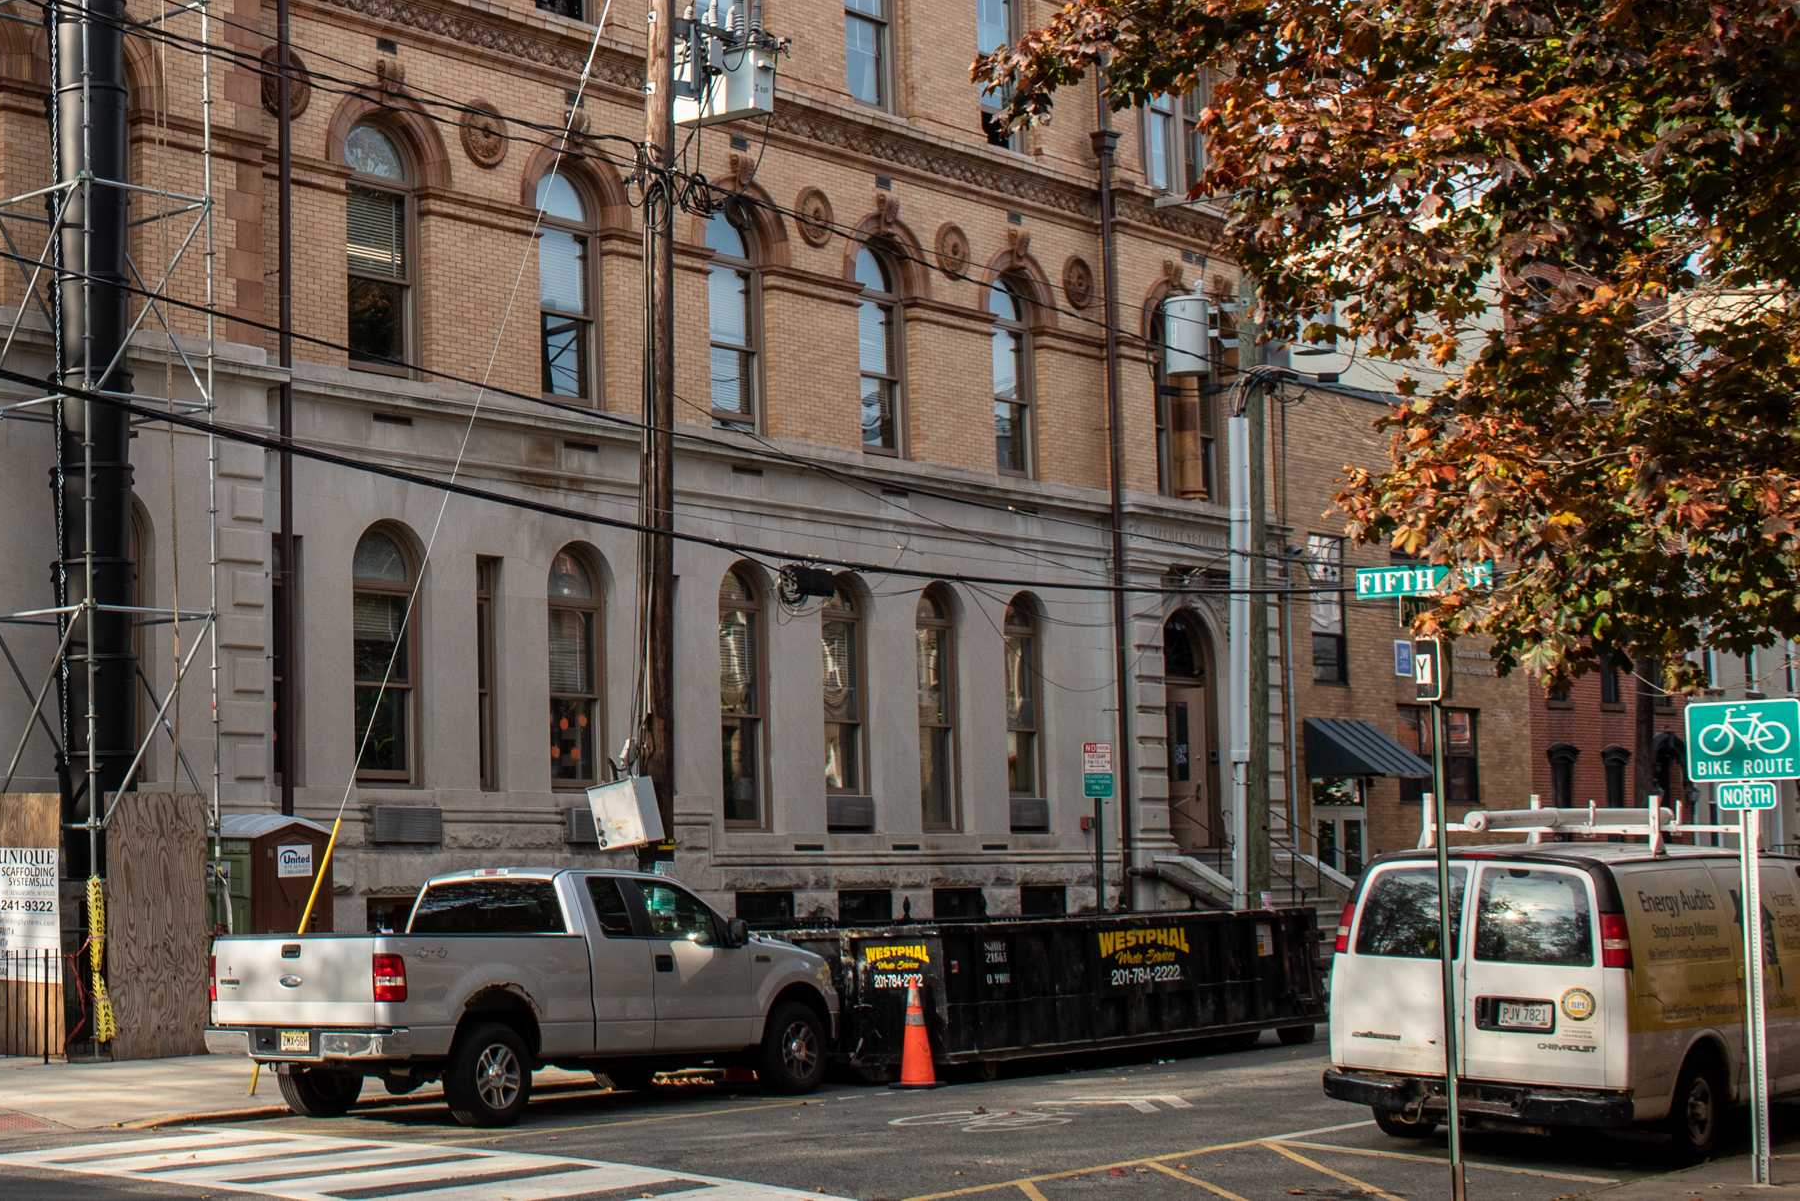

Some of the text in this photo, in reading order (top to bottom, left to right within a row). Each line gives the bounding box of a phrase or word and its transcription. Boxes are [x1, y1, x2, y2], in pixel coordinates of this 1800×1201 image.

[1357, 568, 1435, 594] FIFTH
[1085, 744, 1096, 752] NO
[1697, 757, 1795, 776] BIKE ROUTE
[1723, 787, 1772, 806] NORTH
[283, 854, 310, 865] United
[1, 866, 55, 877] SCAFFOLDING
[8, 877, 55, 888] SYSTEMS,LLC
[1637, 888, 1716, 917] Energy Audits
[1769, 890, 1795, 907] Home
[92, 882, 103, 933] WARNING
[1652, 921, 1718, 941] Stop Losing Money
[1098, 927, 1190, 959] WESTPHAL
[865, 945, 930, 964] WESTPHAL
[1115, 948, 1176, 965] Waste Services
[874, 973, 924, 989] 201-784-22
[1111, 964, 1182, 986] 201-784-2222
[1571, 1000, 1586, 1009] BPI
[1503, 1007, 1547, 1022] PJV 7821
[1537, 1043, 1597, 1053] CHEVROLET
